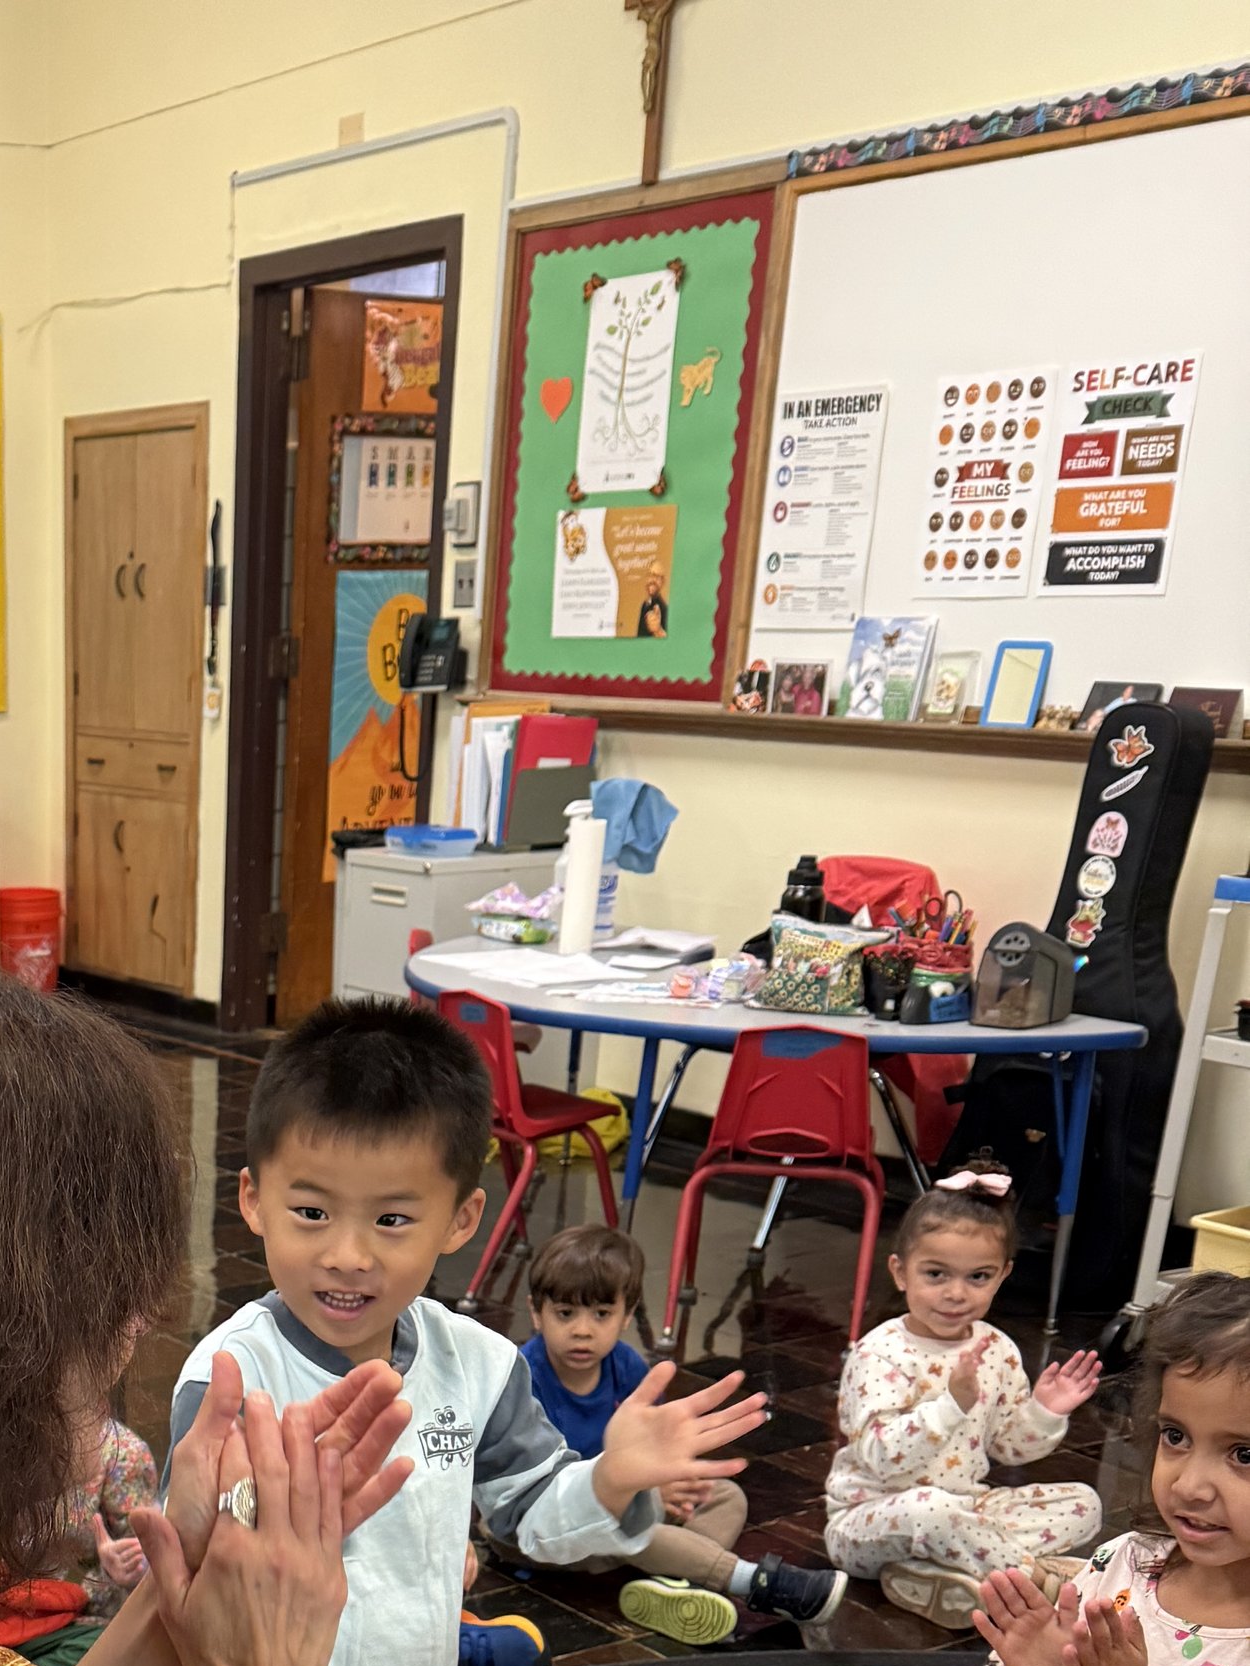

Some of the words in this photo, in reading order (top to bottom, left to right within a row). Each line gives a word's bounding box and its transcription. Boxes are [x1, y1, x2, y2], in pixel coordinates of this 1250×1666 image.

[1072, 358, 1196, 393] SELF-CARE
[783, 402, 795, 419] IN
[797, 400, 812, 418] AN
[815, 393, 883, 416] EMERGENCY
[1102, 396, 1154, 415] CHECK
[804, 419, 824, 429] TAKE
[826, 417, 858, 428] ACTION
[1128, 442, 1175, 460] NEEDS
[972, 463, 995, 478] MY
[1065, 457, 1111, 471] FEELING?
[951, 483, 1012, 499] FEELINGS
[1084, 491, 1108, 500] WHAT
[1109, 490, 1127, 499] ARE
[1128, 489, 1147, 498] YOU
[1079, 501, 1148, 517] GRATEFUL
[1064, 546, 1086, 556] WHAT
[1088, 546, 1100, 555] DO
[1102, 545, 1118, 554] YOU
[1119, 544, 1142, 554] WANT
[1144, 544, 1155, 552] TO
[1065, 556, 1147, 571] ACCOMPLISH
[1089, 571, 1119, 580] TODAY?
